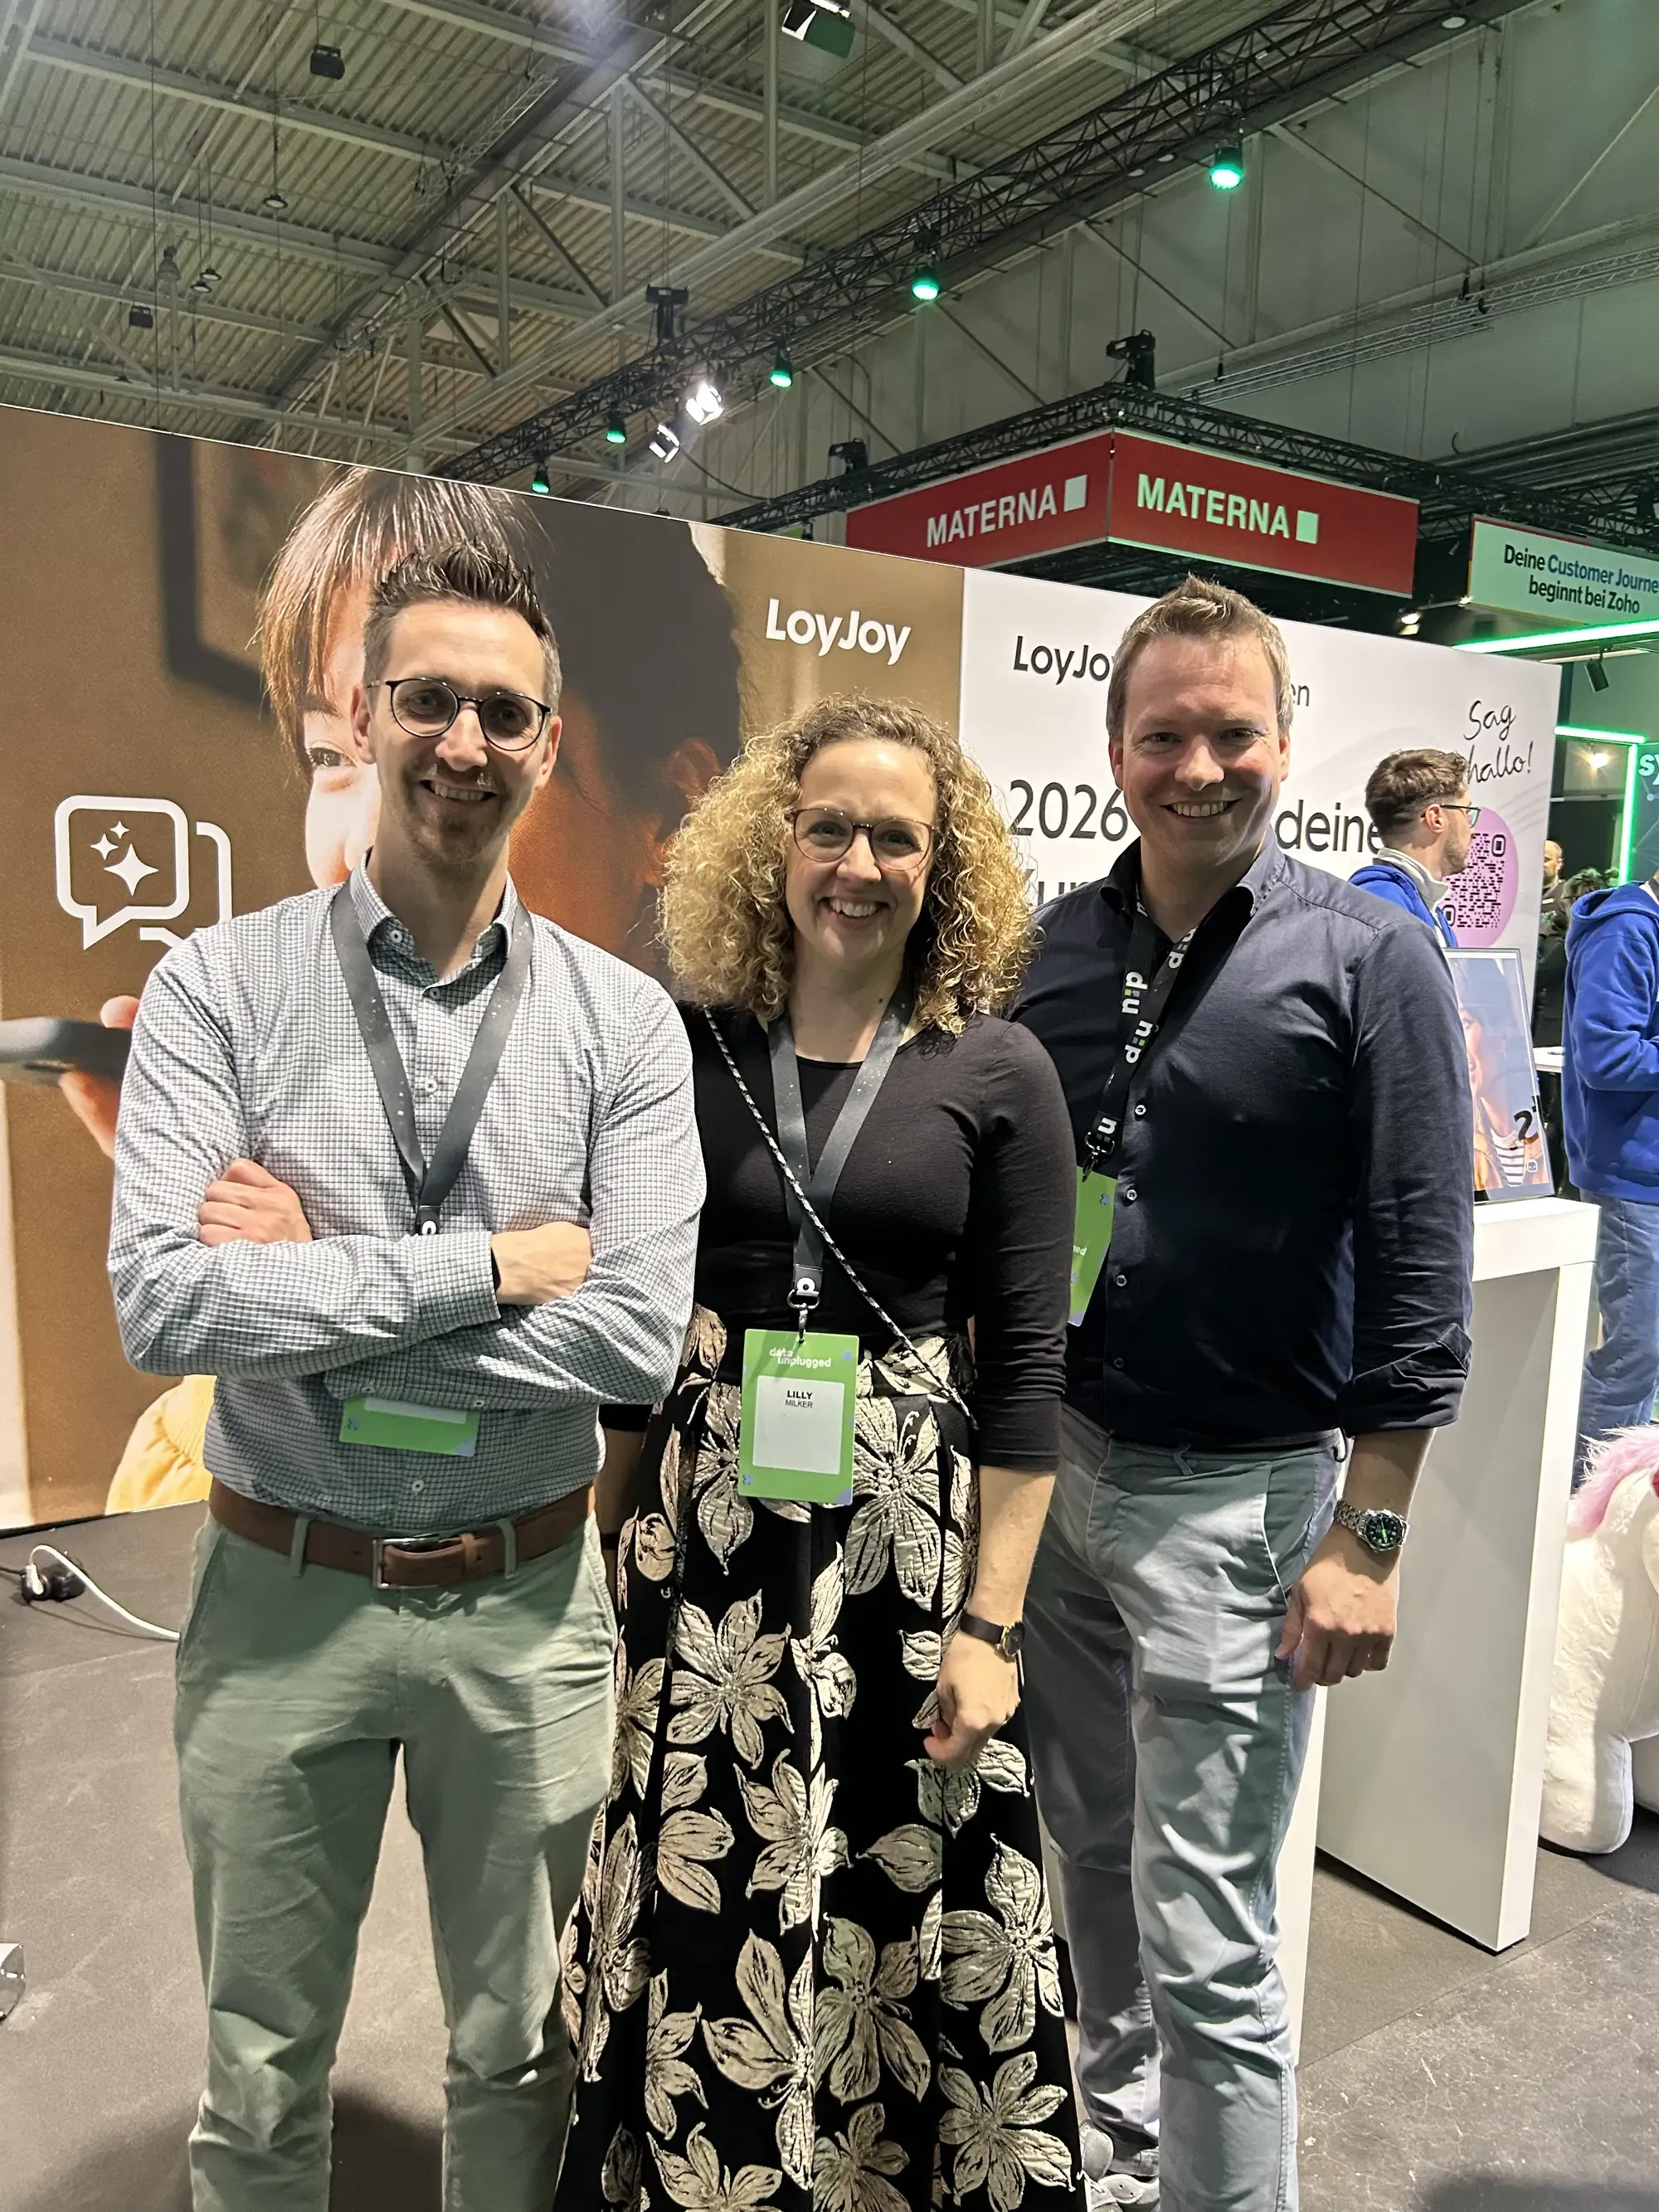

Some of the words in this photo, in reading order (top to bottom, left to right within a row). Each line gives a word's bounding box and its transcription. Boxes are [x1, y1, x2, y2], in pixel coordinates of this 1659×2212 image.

[927, 484, 1058, 547] MATERNA
[1137, 474, 1290, 539] MATERNA
[1504, 544, 1545, 571] Deine
[1548, 554, 1614, 585] Customer
[1529, 575, 1583, 603] beginnt
[1585, 586, 1606, 608] bei
[1608, 591, 1640, 615] Zoho
[766, 598, 912, 665] LoyJoy
[1013, 635, 1115, 685] LoyJo
[1463, 700, 1515, 741] Sag
[1467, 741, 1534, 785] hallo!
[1010, 780, 1128, 842] 2026
[769, 1347, 794, 1358] data
[777, 1355, 832, 1369] unplugged
[785, 1399, 814, 1408] MILKER
[787, 1390, 813, 1400] LILLY
